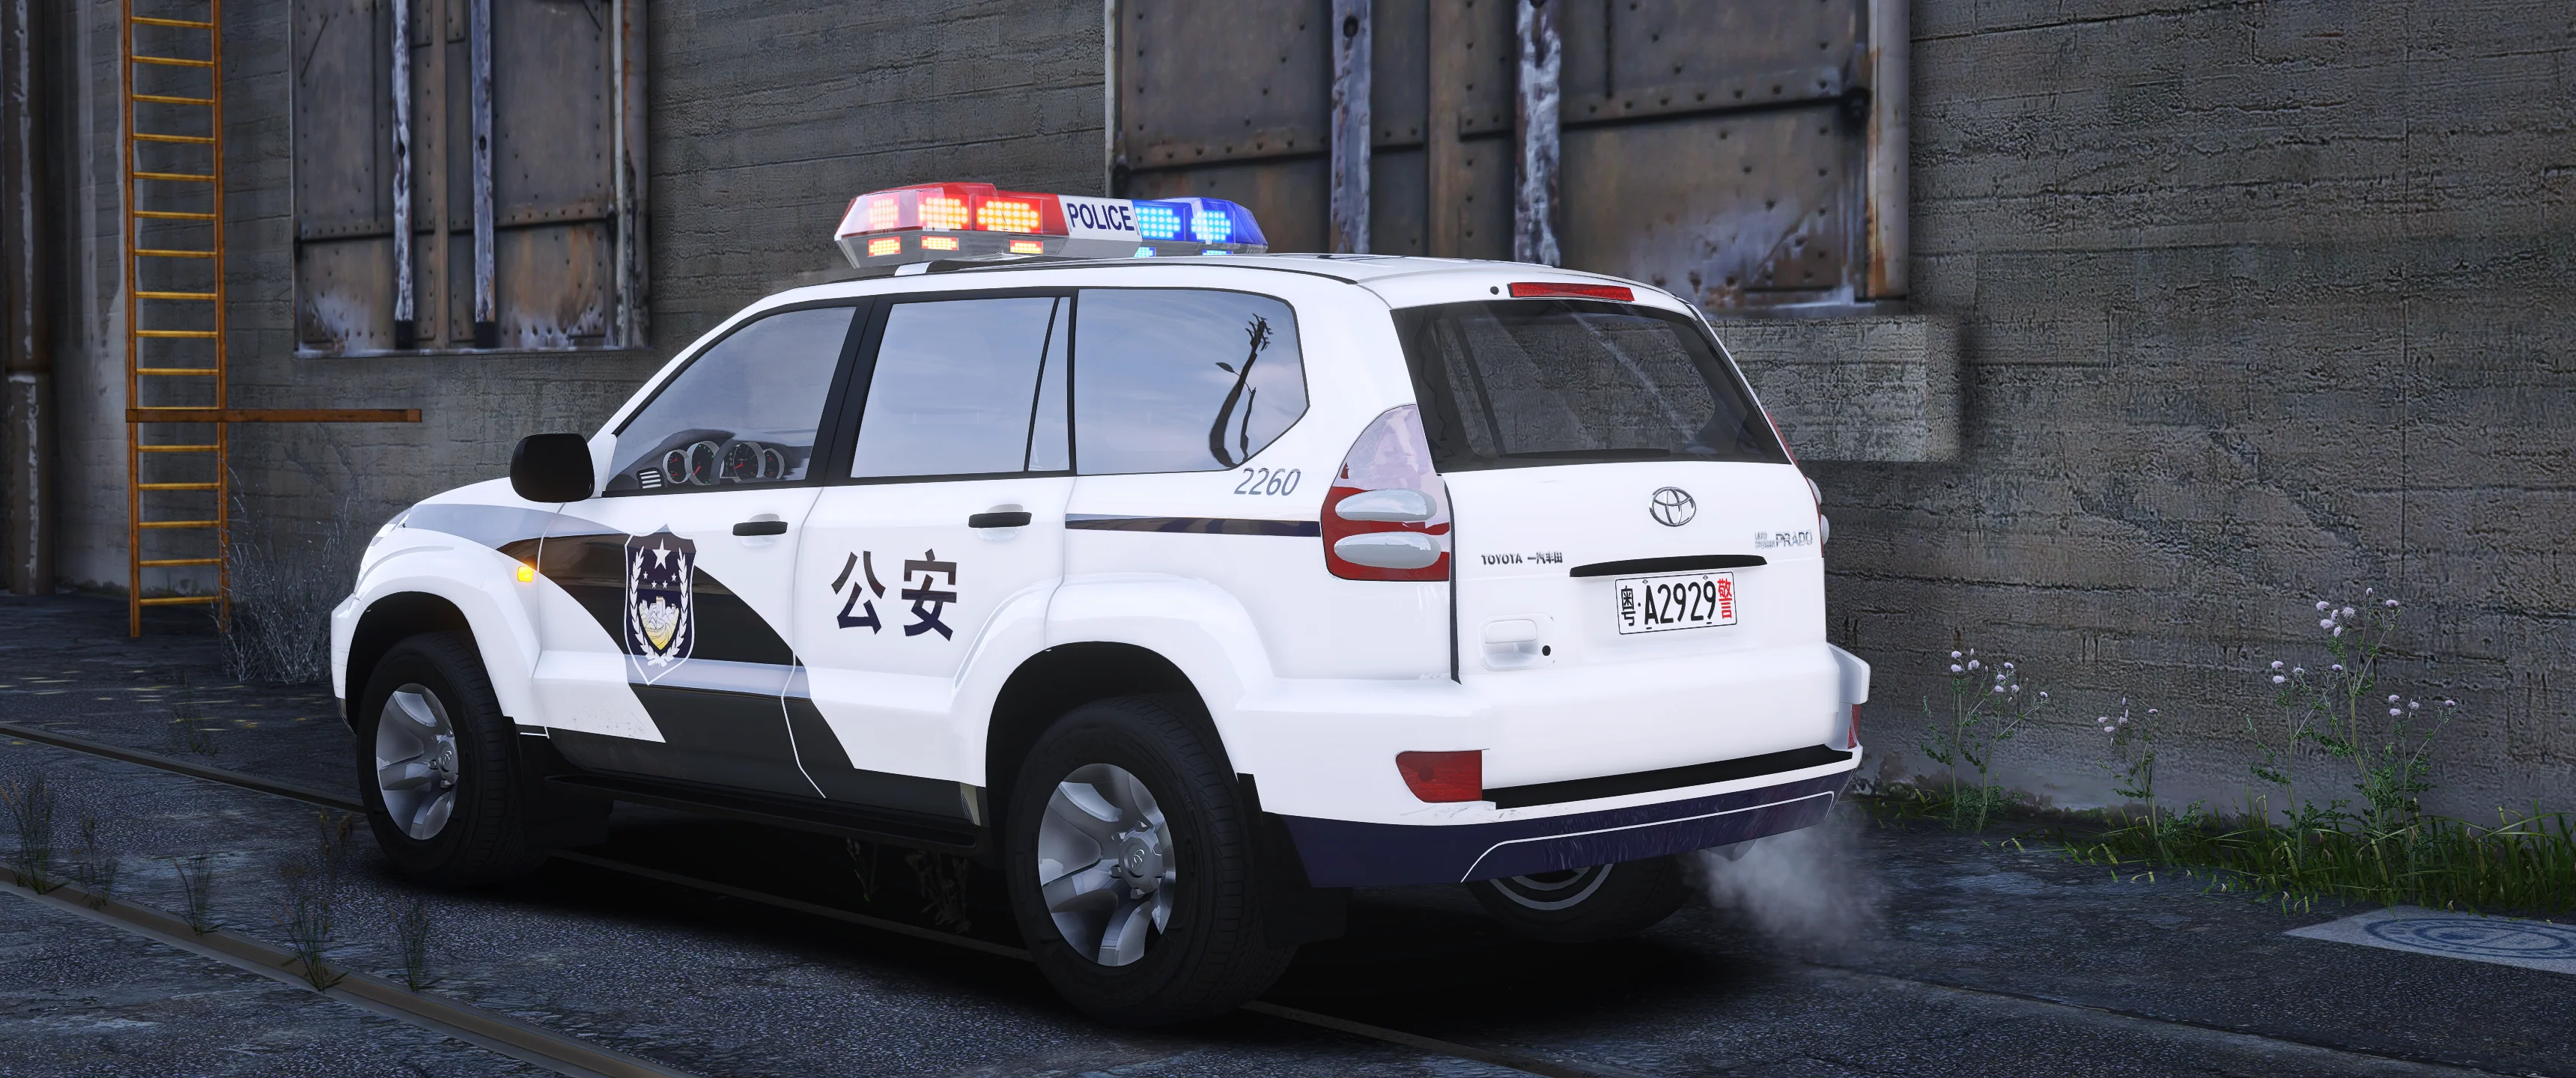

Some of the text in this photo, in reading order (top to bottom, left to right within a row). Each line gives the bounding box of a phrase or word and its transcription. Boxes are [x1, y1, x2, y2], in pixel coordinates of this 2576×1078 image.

[1066, 203, 1135, 231] POLICE
[1233, 467, 1301, 496] 2260
[1775, 529, 1813, 547] PRADO
[1481, 552, 1522, 564] TOYOTA
[831, 549, 957, 642] 公安
